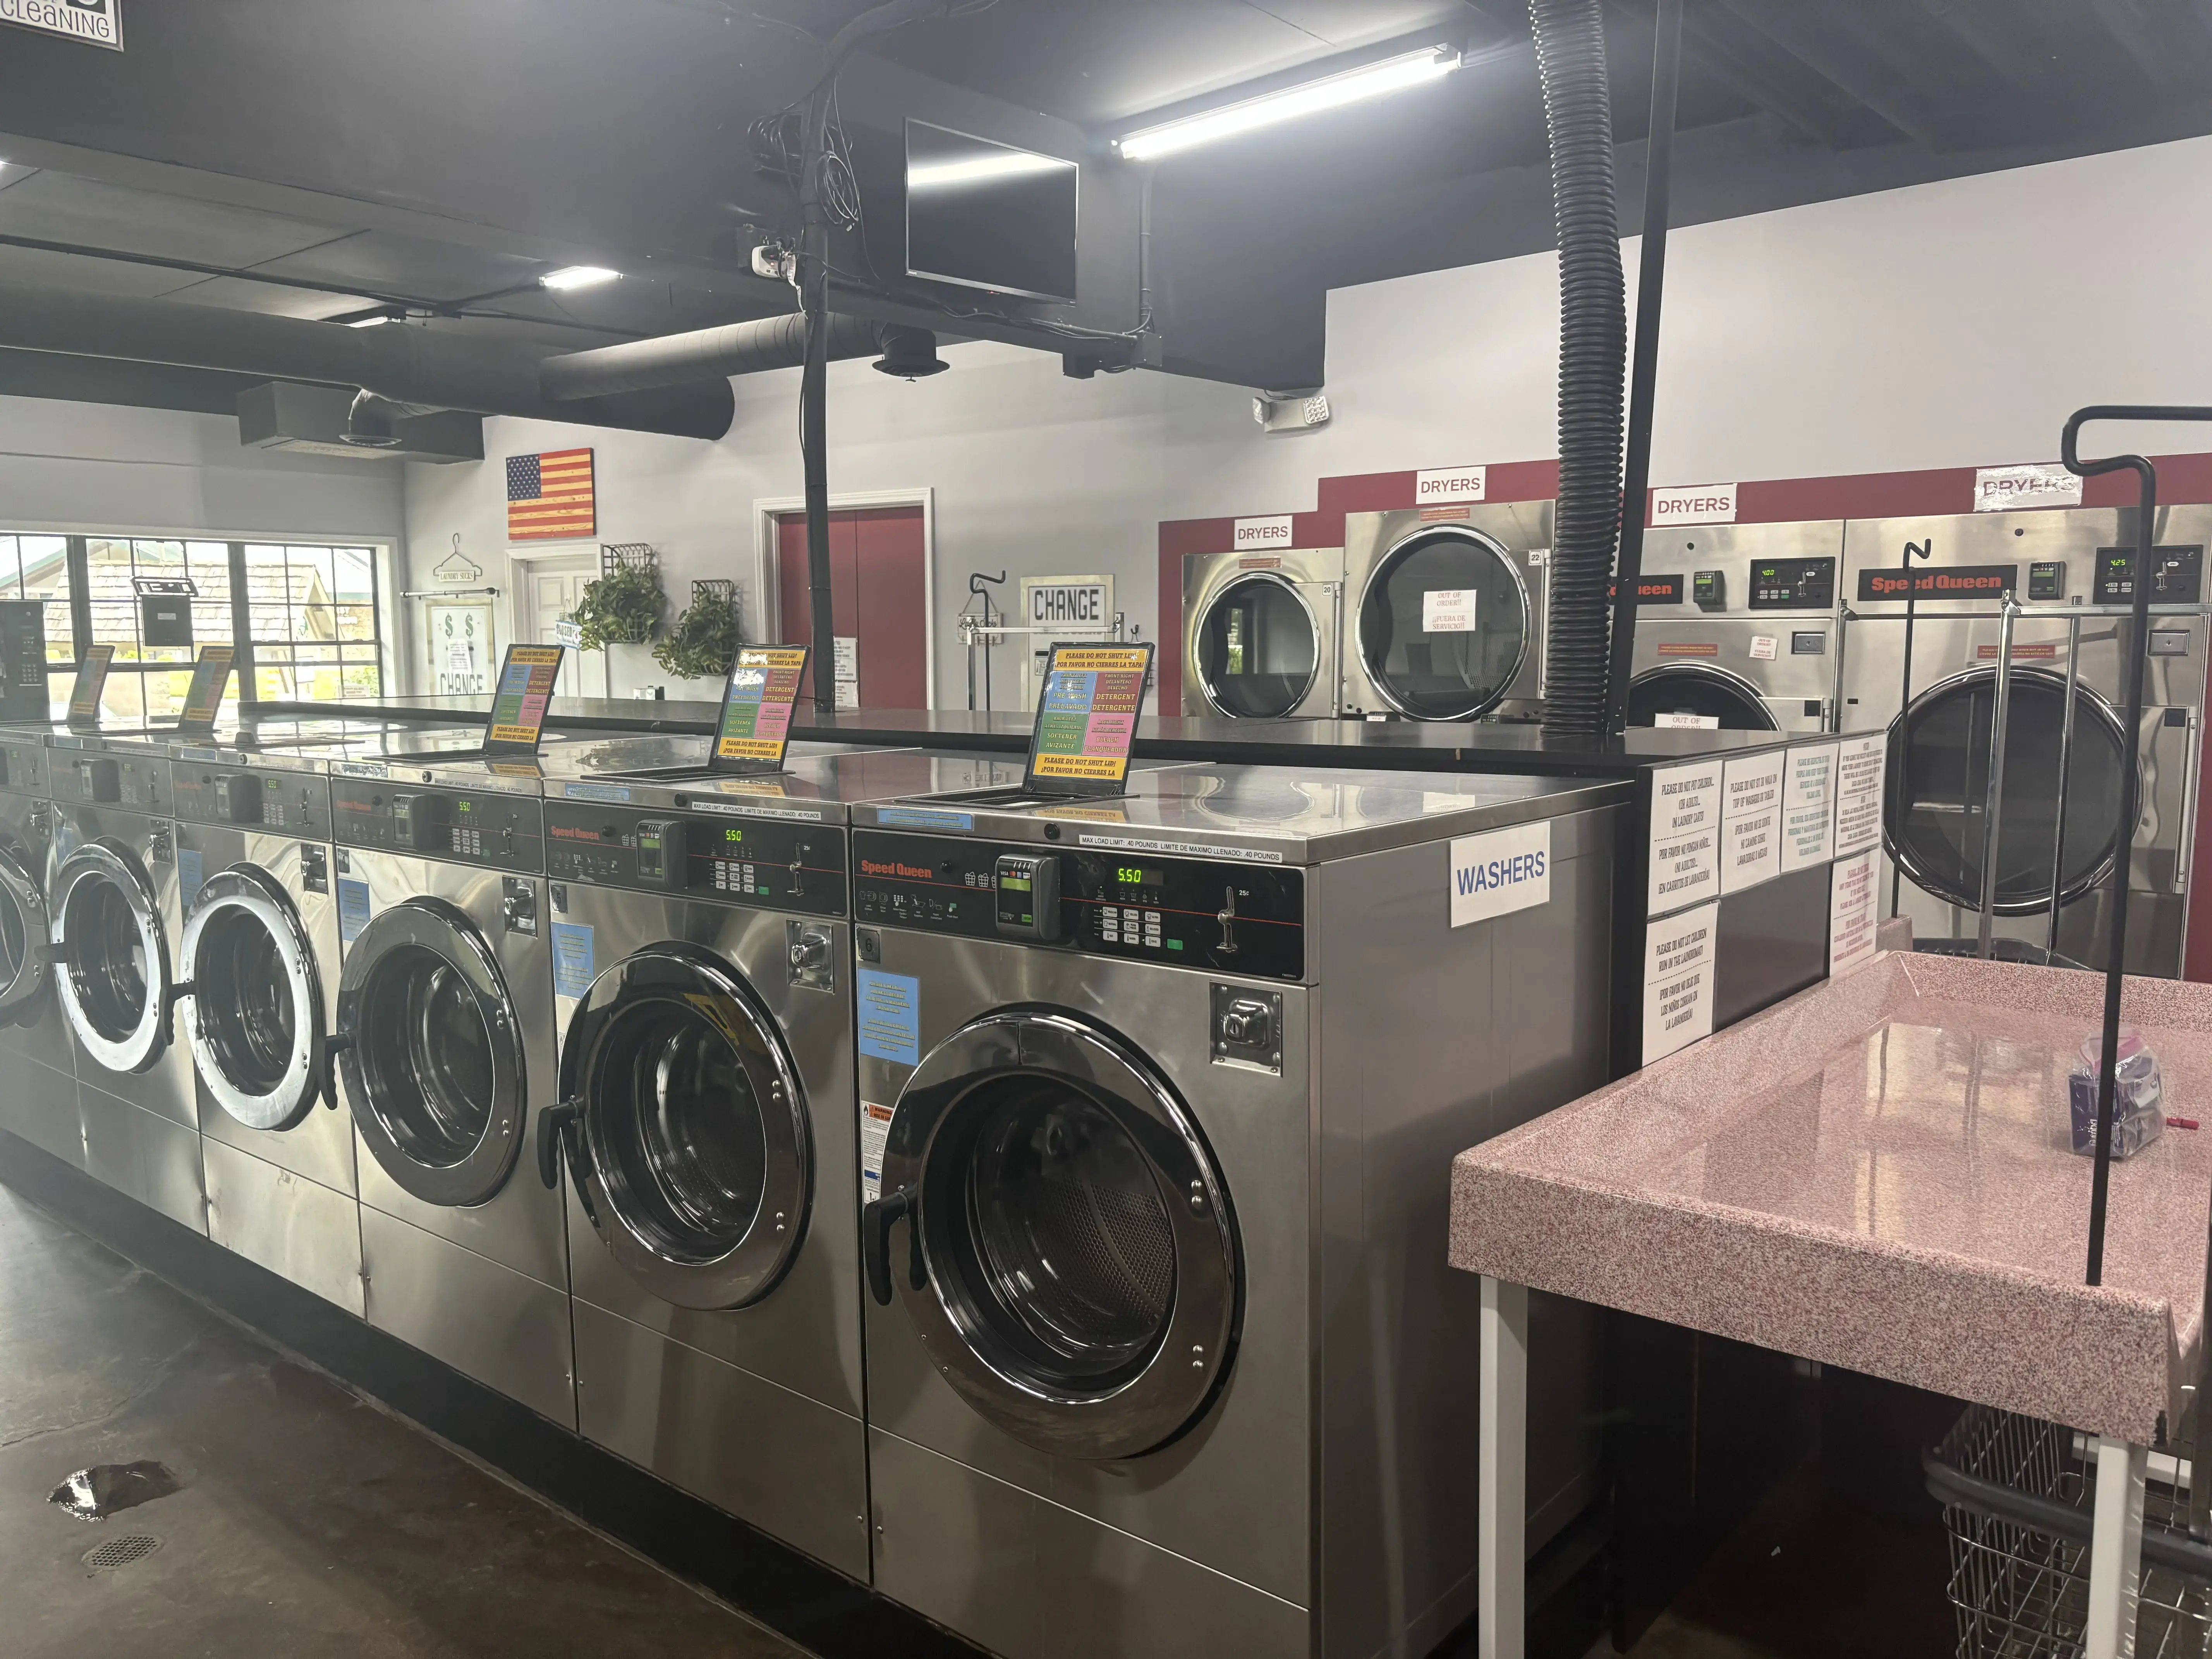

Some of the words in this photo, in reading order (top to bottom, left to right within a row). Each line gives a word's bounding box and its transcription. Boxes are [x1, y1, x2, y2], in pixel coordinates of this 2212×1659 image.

[1421, 477, 1480, 493] DRYERS
[1658, 496, 1729, 514] DRYERS
[1239, 526, 1288, 540] DRYERS
[1936, 575, 2001, 588] Queen
[1035, 589, 1099, 620] CHANGE
[556, 623, 572, 637] CLOSED
[440, 673, 483, 696] CHANGE
[1662, 783, 1678, 795] PLEASE
[1678, 782, 1683, 793] DO
[1730, 781, 1744, 793] PLEASE
[1672, 817, 1677, 828] IN
[551, 826, 574, 837] Speed
[575, 828, 599, 840] Queen
[1213, 848, 1242, 857] LLENADO:
[1659, 848, 1668, 860] POR
[1668, 845, 1680, 858] FAVOR
[861, 860, 895, 874] Speed
[896, 863, 933, 878] Queen
[1118, 868, 1141, 883] 5.50
[1457, 851, 1544, 895] WASHERS
[556, 893, 561, 903] 5
[866, 937, 872, 952] 6
[1656, 941, 1671, 956] PLEASE
[1672, 939, 1677, 951] DO
[1659, 959, 1668, 972] RUN
[1668, 957, 1673, 969] IN
[1669, 983, 1680, 997] FAVOR
[1665, 1019, 1671, 1030] LA
